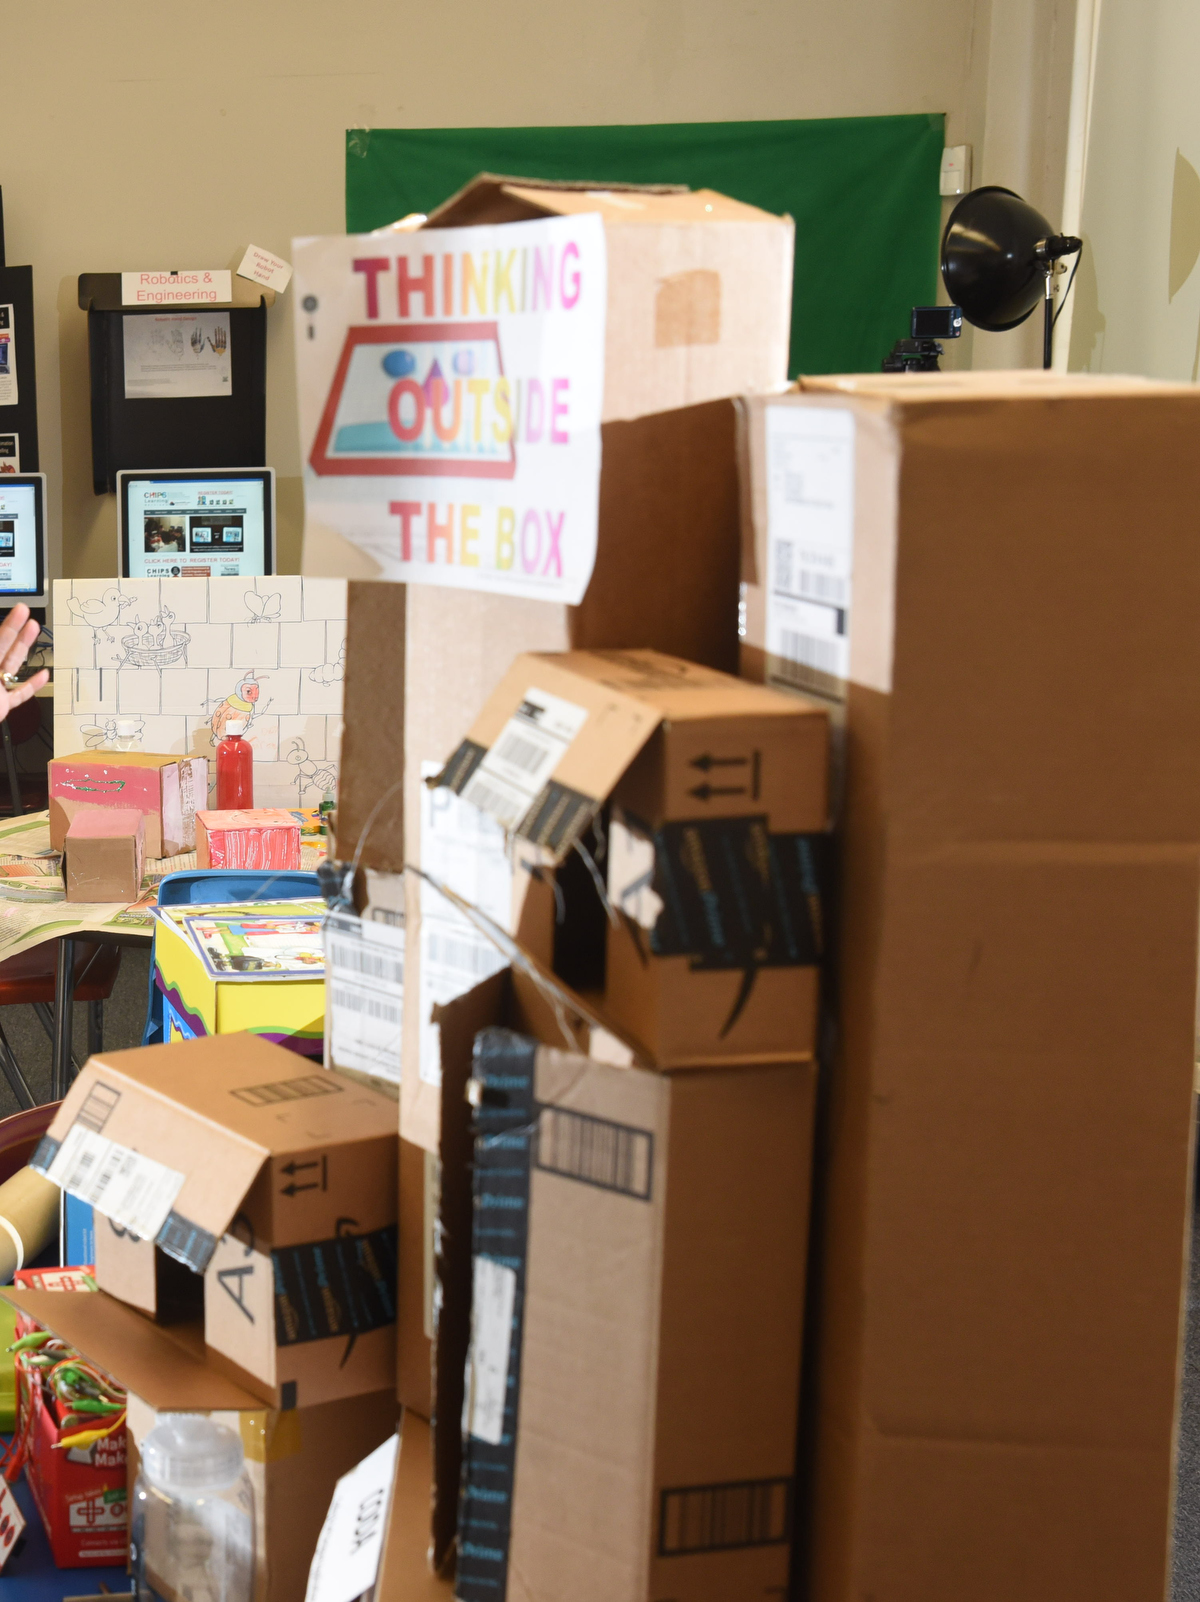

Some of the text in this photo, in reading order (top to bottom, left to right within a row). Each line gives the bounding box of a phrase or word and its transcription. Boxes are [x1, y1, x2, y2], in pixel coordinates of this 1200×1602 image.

[253, 252, 284, 270] Draw Your
[256, 262, 274, 274] Robot
[140, 272, 213, 285] Robotics &
[254, 270, 270, 281] Hand
[352, 242, 582, 320] THINKING
[136, 288, 217, 304] Engineering
[388, 378, 570, 444] OUTSIDE
[389, 502, 565, 578] THE BOX
[96, 1436, 127, 1451] Mak
[95, 1451, 127, 1467] Mak
